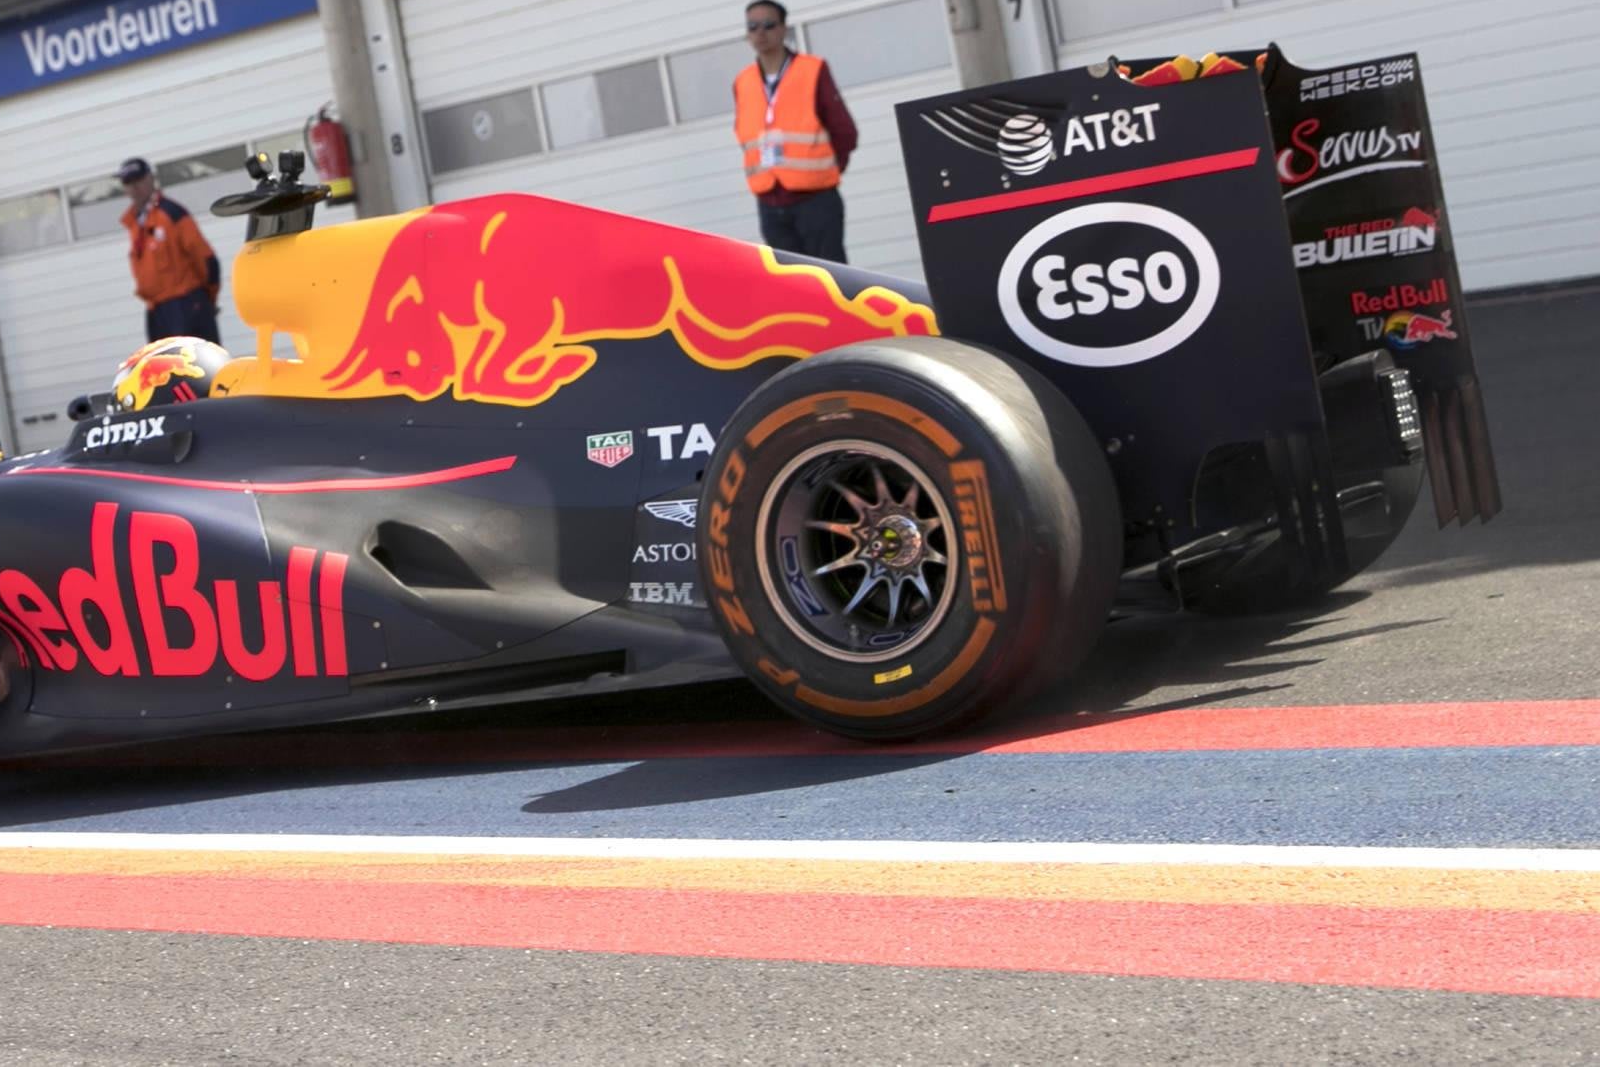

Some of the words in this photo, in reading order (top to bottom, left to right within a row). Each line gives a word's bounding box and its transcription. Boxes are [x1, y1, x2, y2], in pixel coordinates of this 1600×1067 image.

[1300, 65, 1378, 91] SPEED
[1300, 71, 1414, 102] WEEK.COM
[1063, 103, 1161, 156] AT&T
[1324, 224, 1358, 239] THE
[1360, 219, 1395, 233] RED
[1352, 283, 1398, 315] Red
[1400, 278, 1448, 307] Bull
[1356, 316, 1385, 341] TV
[591, 435, 628, 448] TAG
[632, 542, 697, 563] ASTO
[129, 511, 349, 682] Bull
[629, 582, 695, 606] IBM
